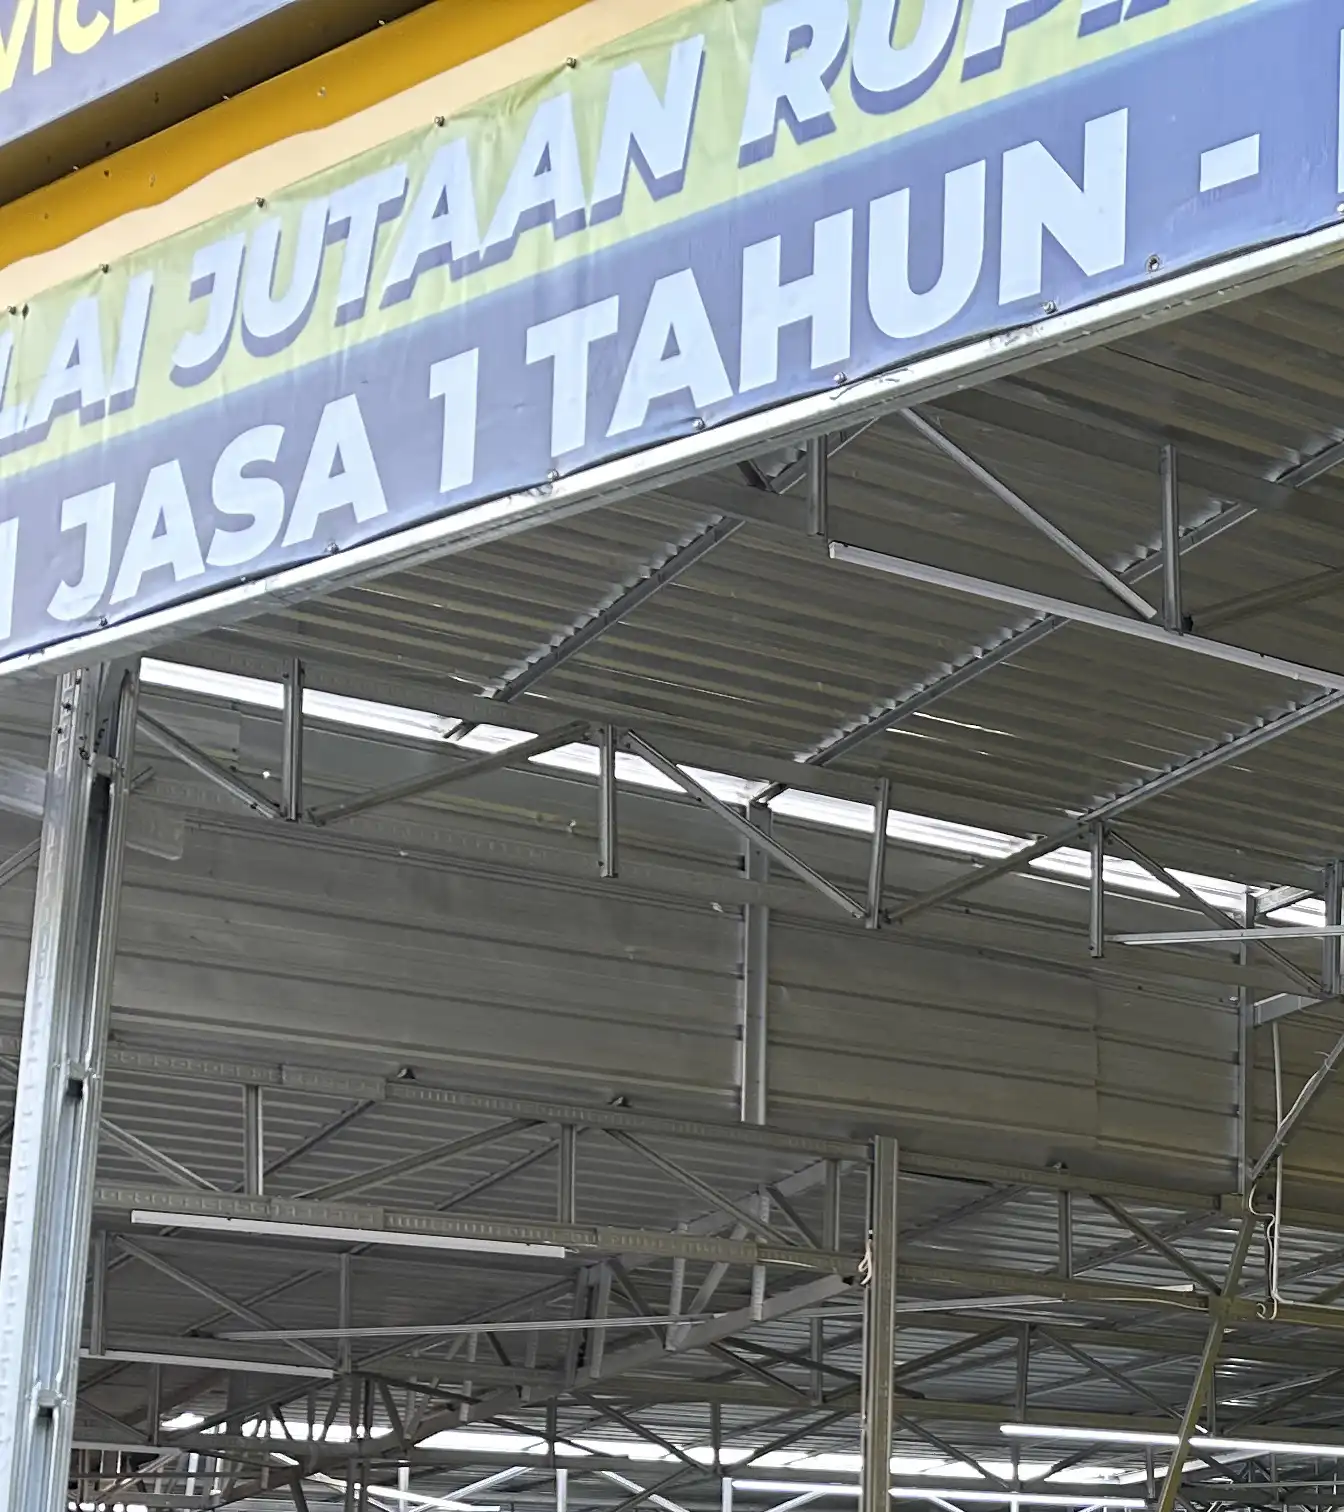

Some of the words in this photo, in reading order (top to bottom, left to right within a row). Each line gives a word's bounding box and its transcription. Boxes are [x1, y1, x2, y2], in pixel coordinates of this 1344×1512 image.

[46, 393, 389, 621] JASA
[429, 347, 479, 493] 1
[525, 107, 1129, 458] TAHUN
[169, 34, 706, 386] JUTAAN
